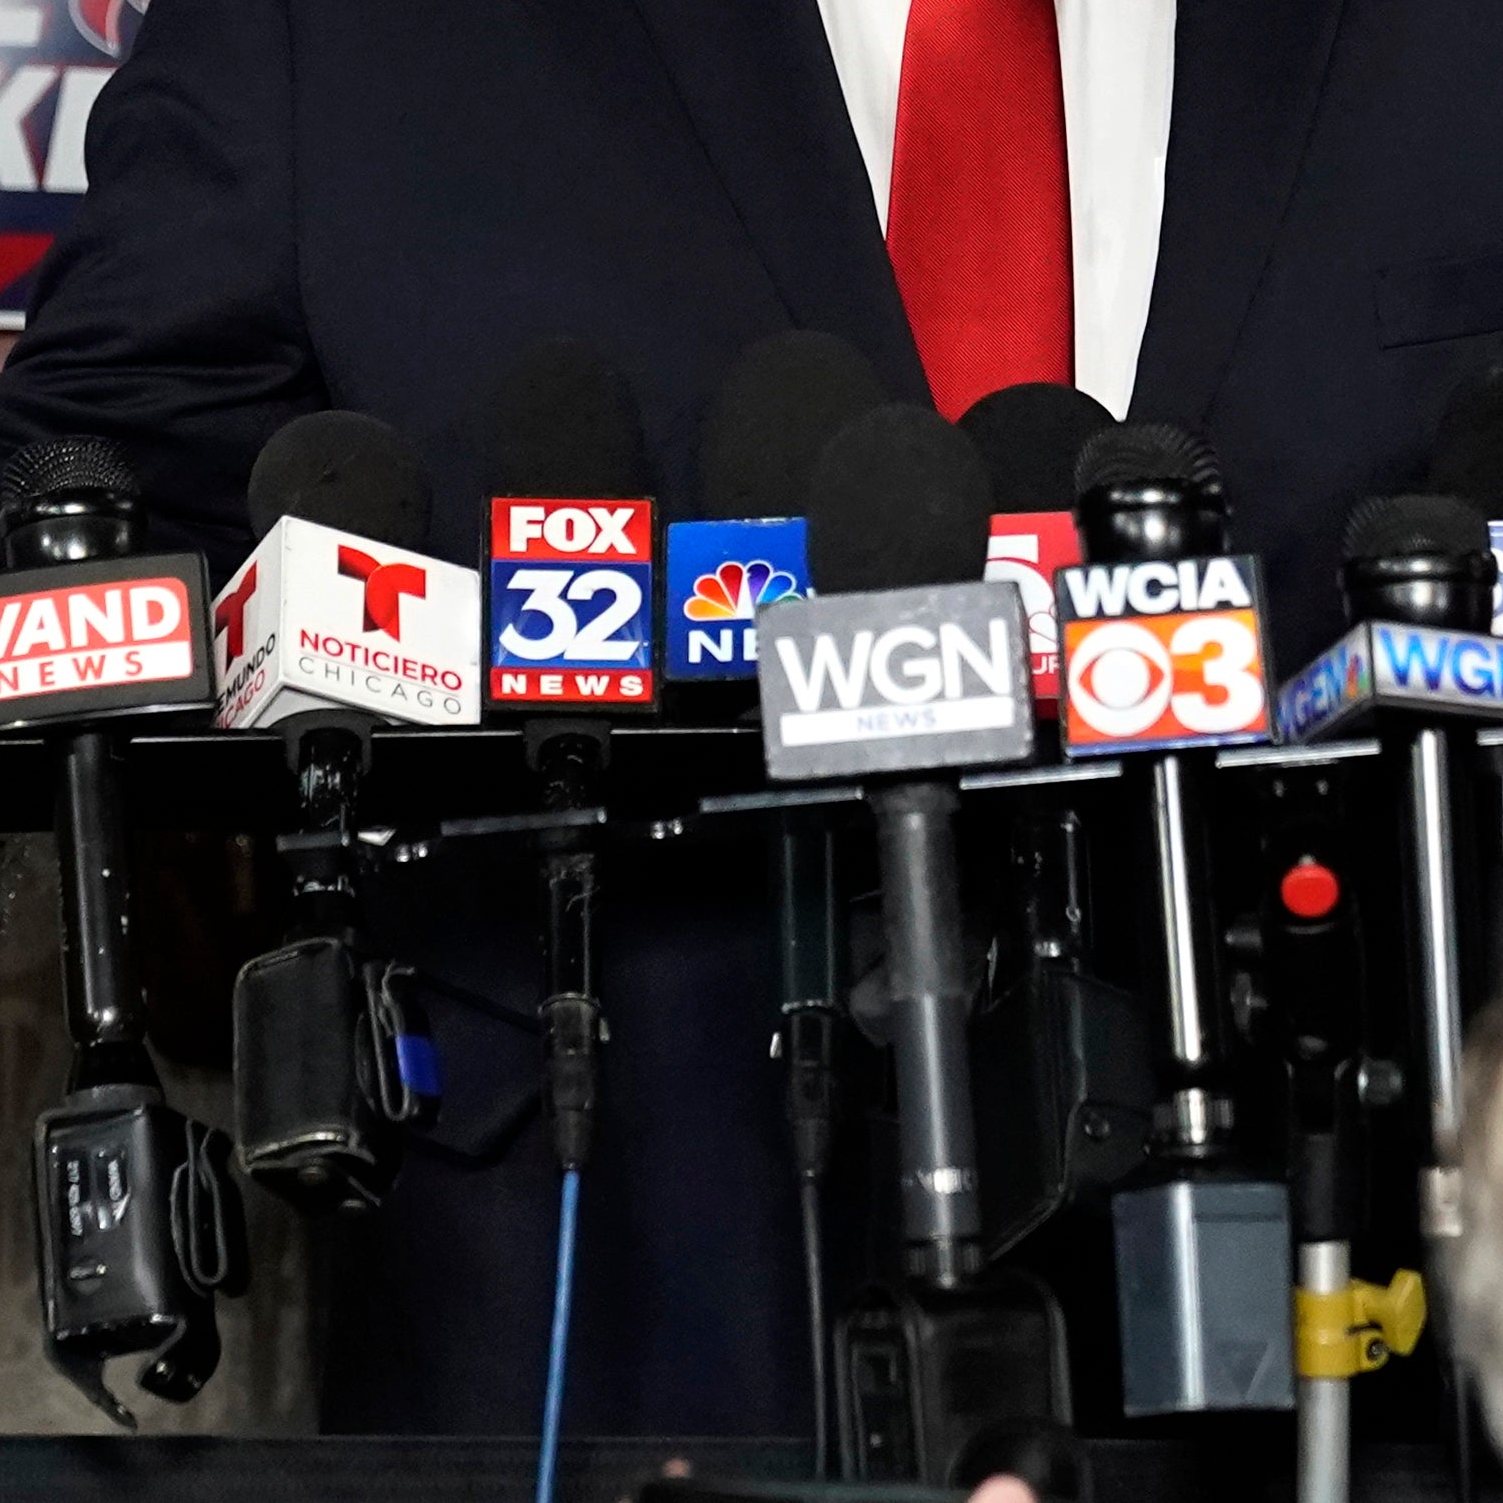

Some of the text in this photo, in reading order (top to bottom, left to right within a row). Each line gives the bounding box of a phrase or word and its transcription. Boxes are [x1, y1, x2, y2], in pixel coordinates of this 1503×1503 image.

[509, 505, 637, 555] FOX
[499, 569, 643, 661] 32
[1065, 557, 1251, 618] WCIA
[215, 632, 276, 716] EMUNDO
[298, 656, 462, 716] CHICAGO
[300, 629, 462, 691] NOTICIERO
[501, 673, 644, 696] NEWS
[775, 618, 1011, 713] WGN
[1170, 617, 1265, 734] 3
[216, 668, 266, 729] ICAGO
[856, 709, 936, 733] NEWS
